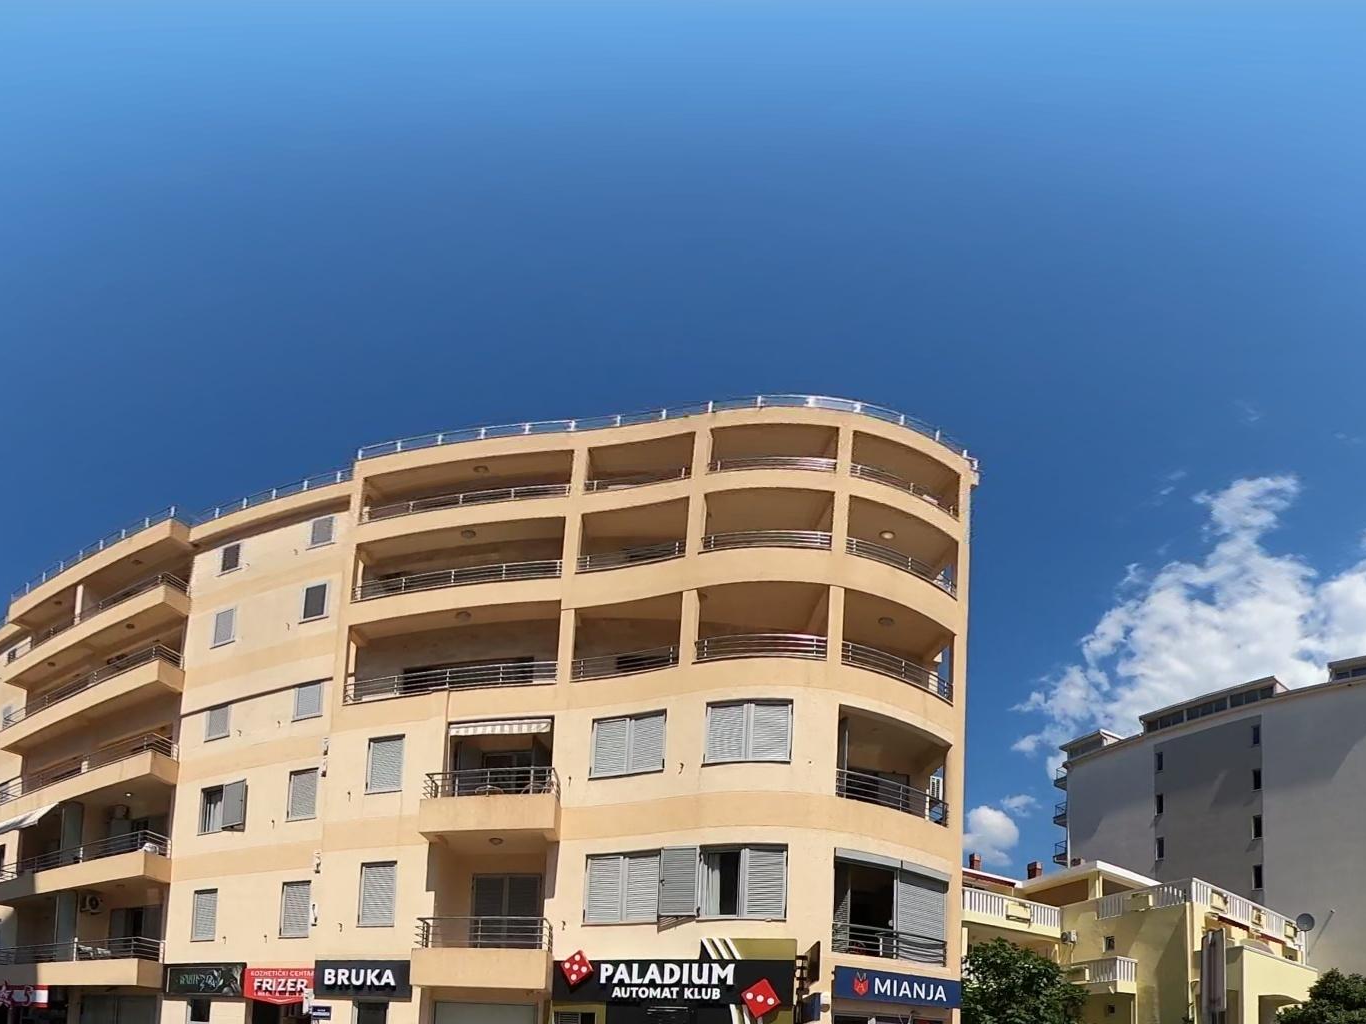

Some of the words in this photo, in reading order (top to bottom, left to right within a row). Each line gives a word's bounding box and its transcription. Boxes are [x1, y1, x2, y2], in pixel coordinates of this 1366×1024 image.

[323, 968, 396, 986] BRUKA
[599, 963, 735, 985] PALADIUM
[253, 978, 308, 992] FRIZER
[611, 987, 679, 999] AUTOMAT
[684, 987, 721, 1000] KLUB
[874, 977, 947, 1002] MIANJA
